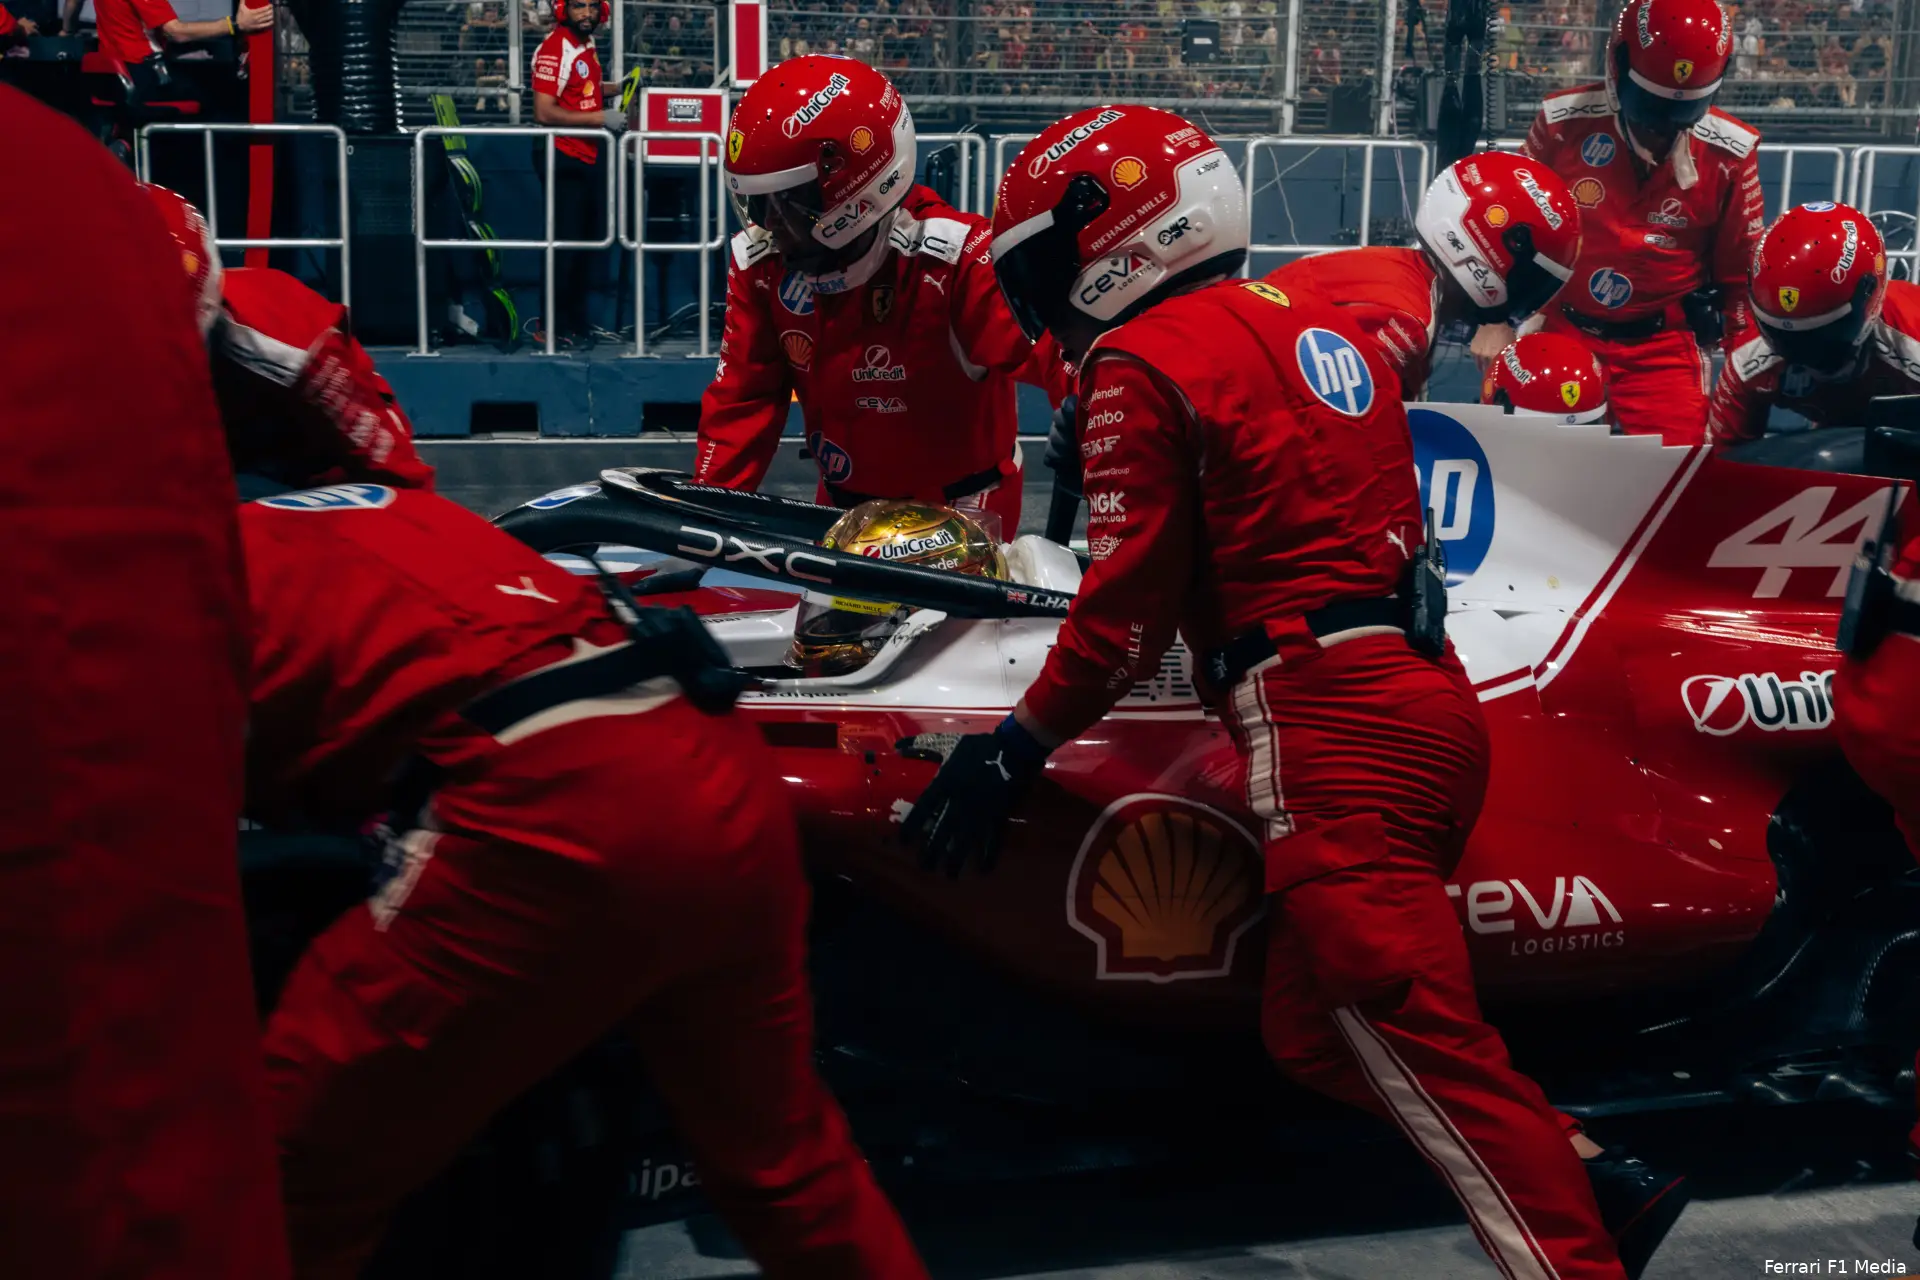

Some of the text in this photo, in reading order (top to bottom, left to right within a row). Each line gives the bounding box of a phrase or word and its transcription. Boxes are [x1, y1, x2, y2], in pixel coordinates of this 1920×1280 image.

[796, 73, 850, 124] UniCredit
[1048, 110, 1124, 161] UniCredit
[1586, 134, 1611, 166] hp
[834, 149, 890, 200] RICHARD MILLE
[1522, 177, 1563, 230] UniCredit
[1648, 212, 1687, 228] UniCredit
[1091, 191, 1169, 251] RICHARD MILLE
[1839, 220, 1857, 270] UniCredit
[1118, 262, 1156, 291] LOGISTICS
[1593, 270, 1629, 306] hp
[853, 366, 905, 381] UniCredit
[1304, 331, 1362, 413] hp
[699, 440, 716, 475] MILLE
[1082, 435, 1121, 458] SKF
[729, 490, 771, 502] MILLE
[1087, 491, 1126, 514] NGK
[1103, 514, 1127, 523] PLUGS
[677, 525, 838, 584] DXC
[881, 529, 955, 560] UniCredit
[1706, 486, 1910, 598] 44
[835, 600, 861, 609] RICHARD
[1511, 930, 1625, 956] LOGISTICS
